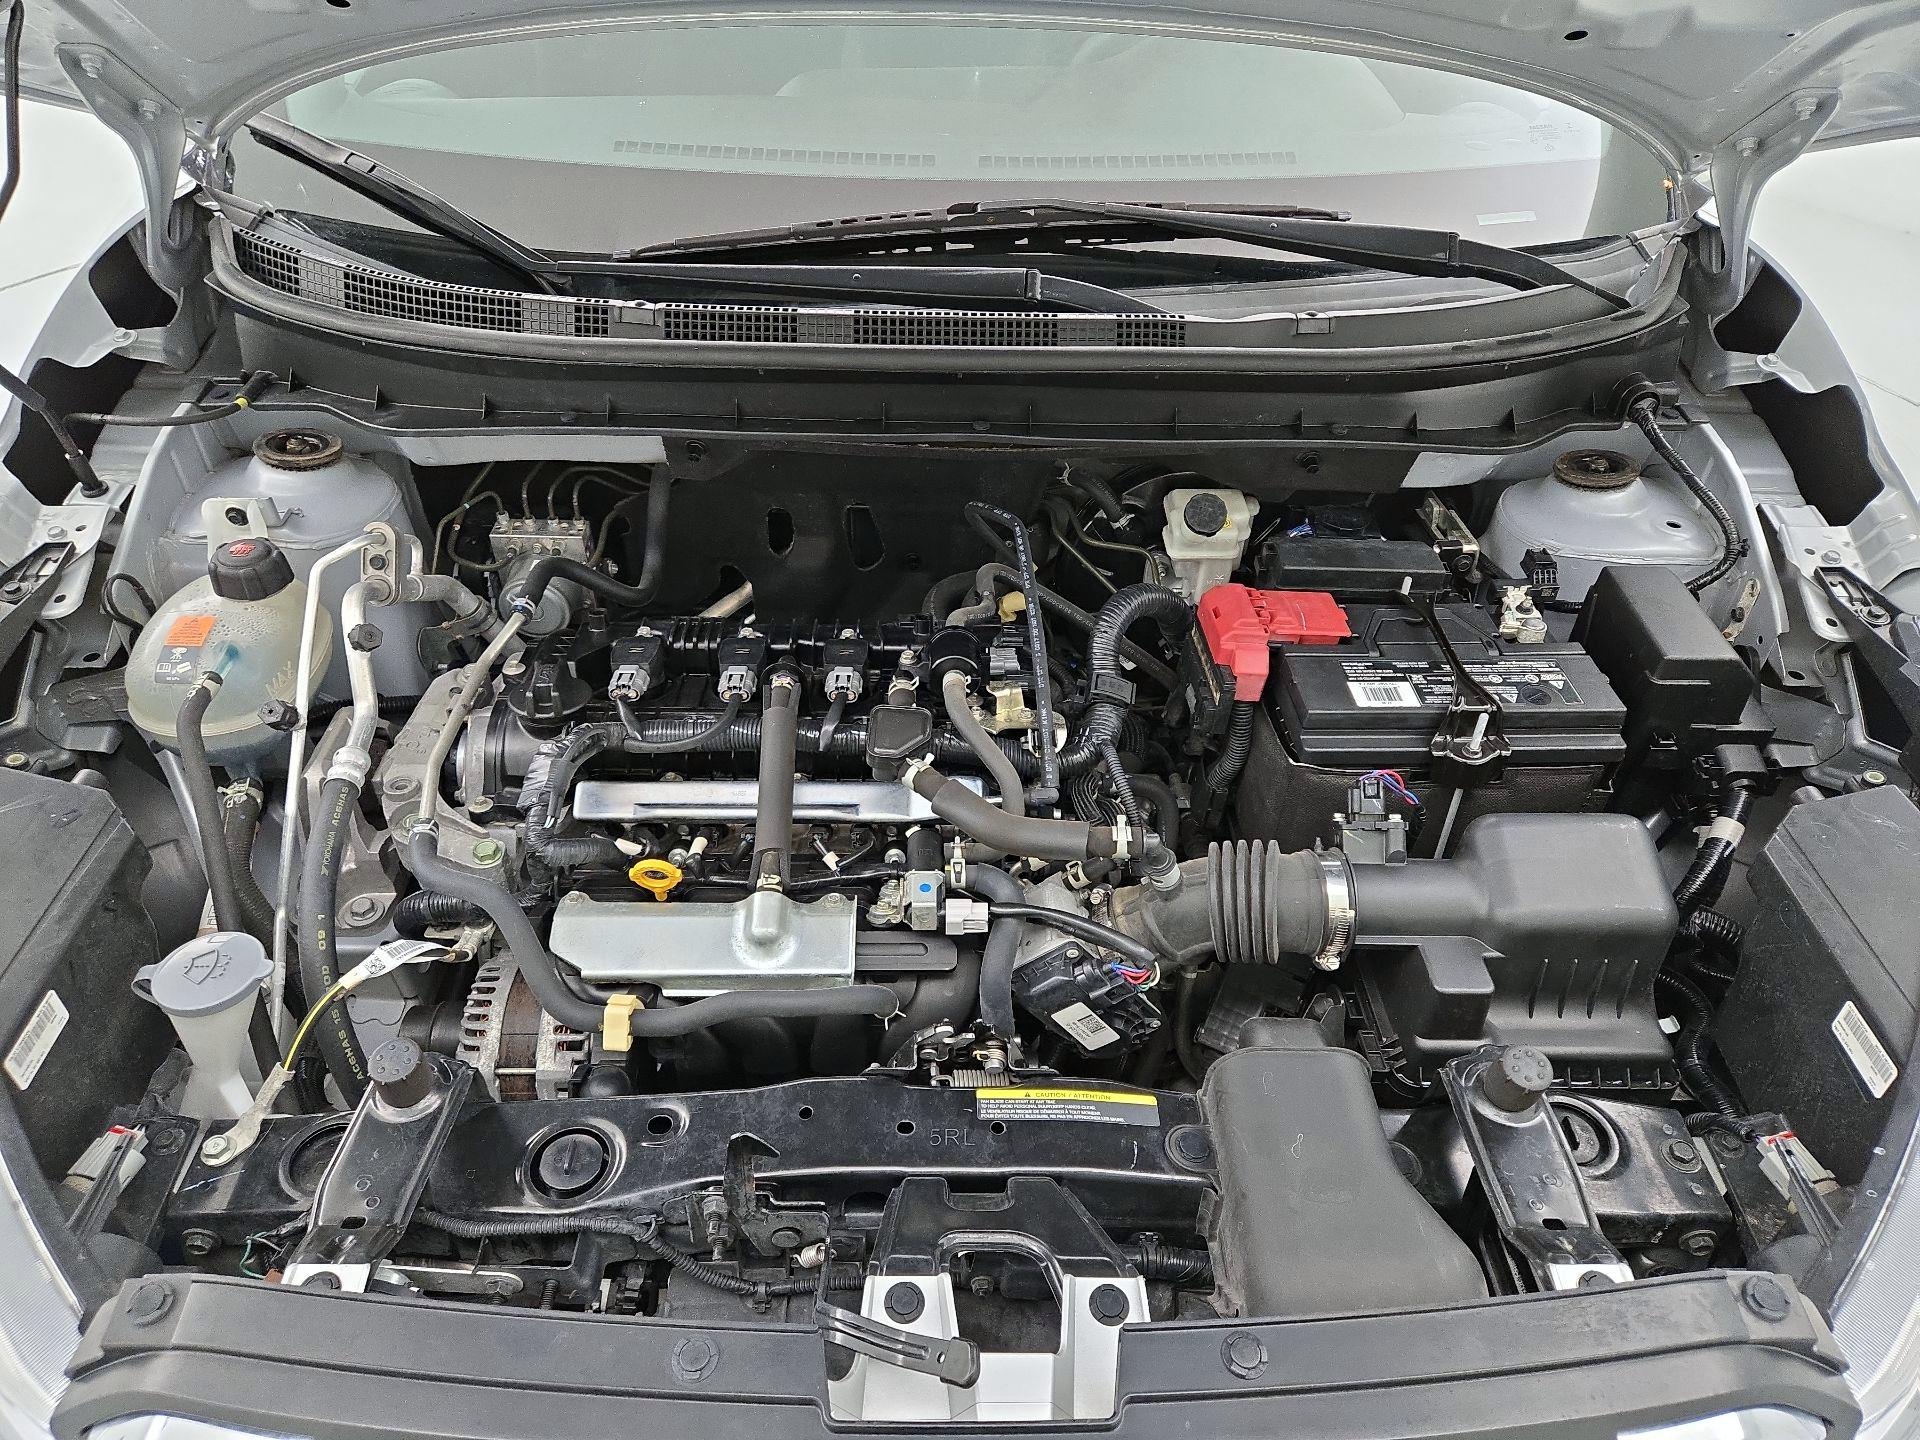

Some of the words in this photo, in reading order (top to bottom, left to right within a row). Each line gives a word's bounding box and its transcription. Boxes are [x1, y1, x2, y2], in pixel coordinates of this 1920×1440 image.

[323, 830, 336, 865] YOKOHAMA
[337, 1028, 365, 1080] AC6HAS
[929, 1127, 976, 1146] 5RL
